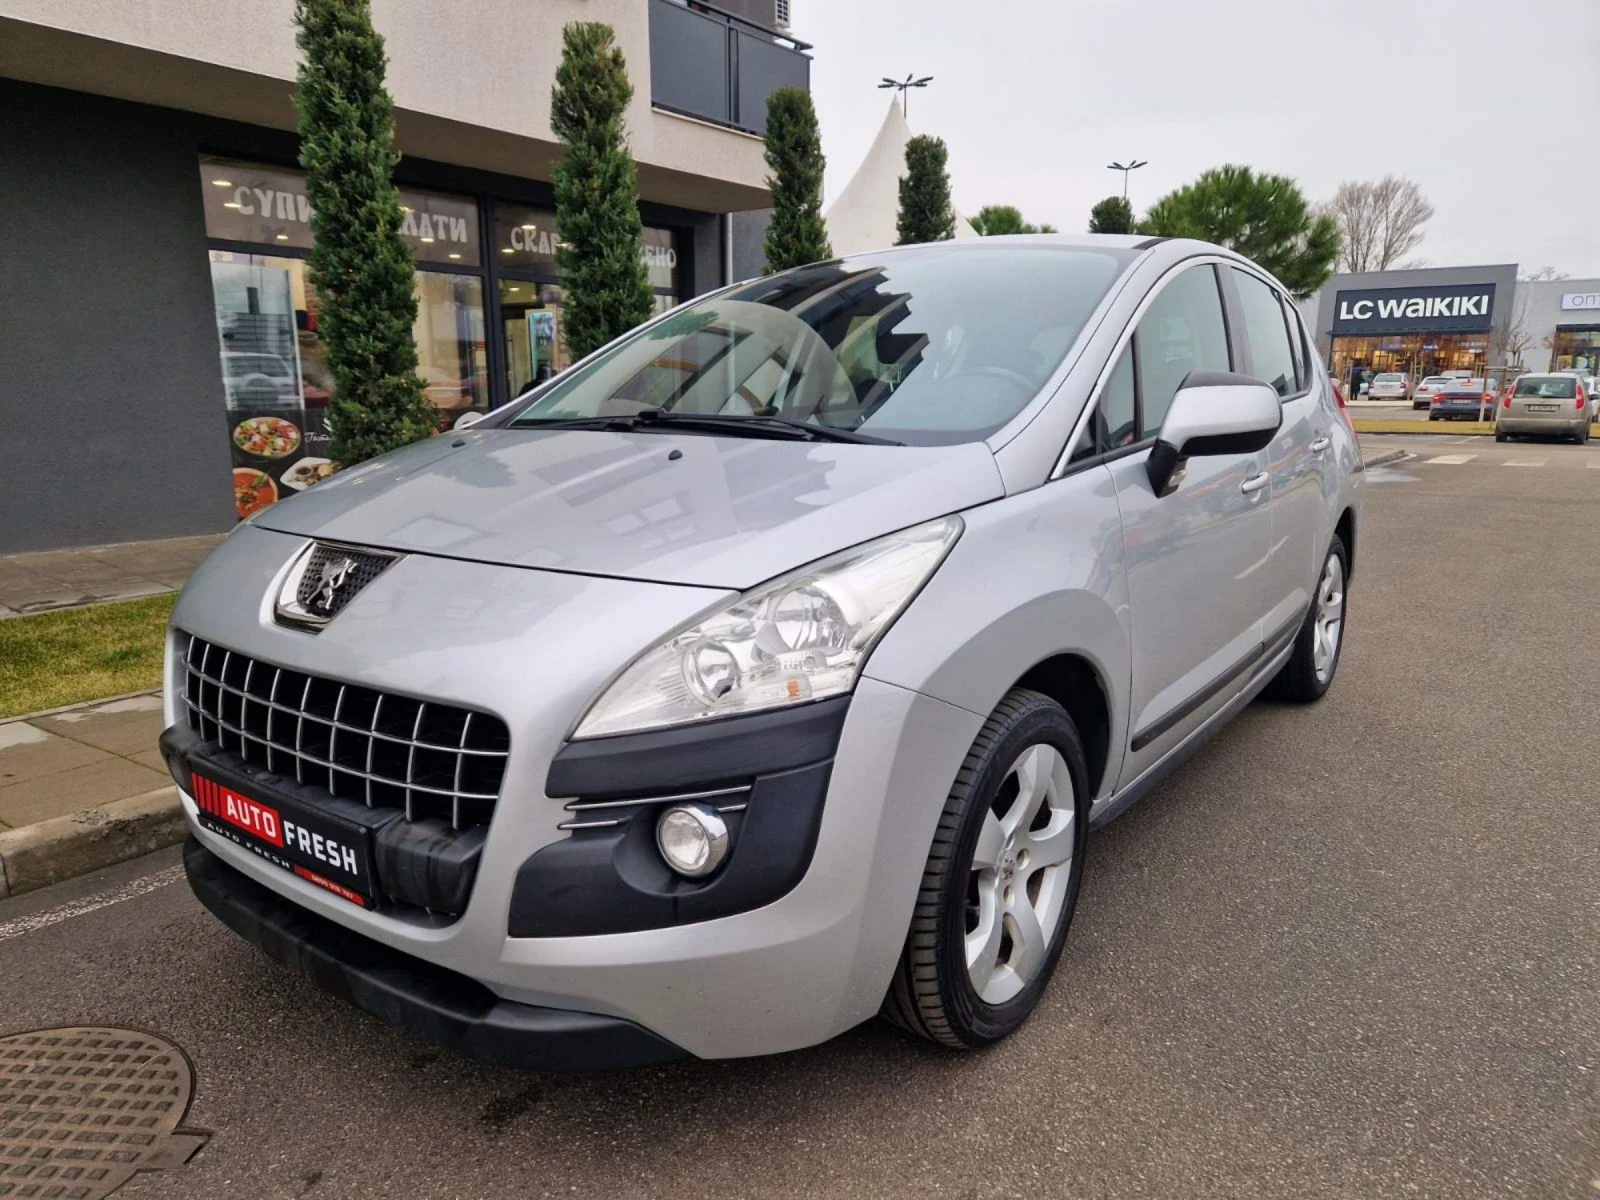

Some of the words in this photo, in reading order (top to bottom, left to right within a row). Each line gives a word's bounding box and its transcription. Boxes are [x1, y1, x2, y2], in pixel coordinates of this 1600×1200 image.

[511, 227, 562, 255] СКАР
[1339, 300, 1374, 320] LC
[207, 822, 240, 843] AUTO
[246, 842, 290, 869] FRESH
[226, 795, 277, 838] AUTO
[283, 820, 358, 876] FRESH
